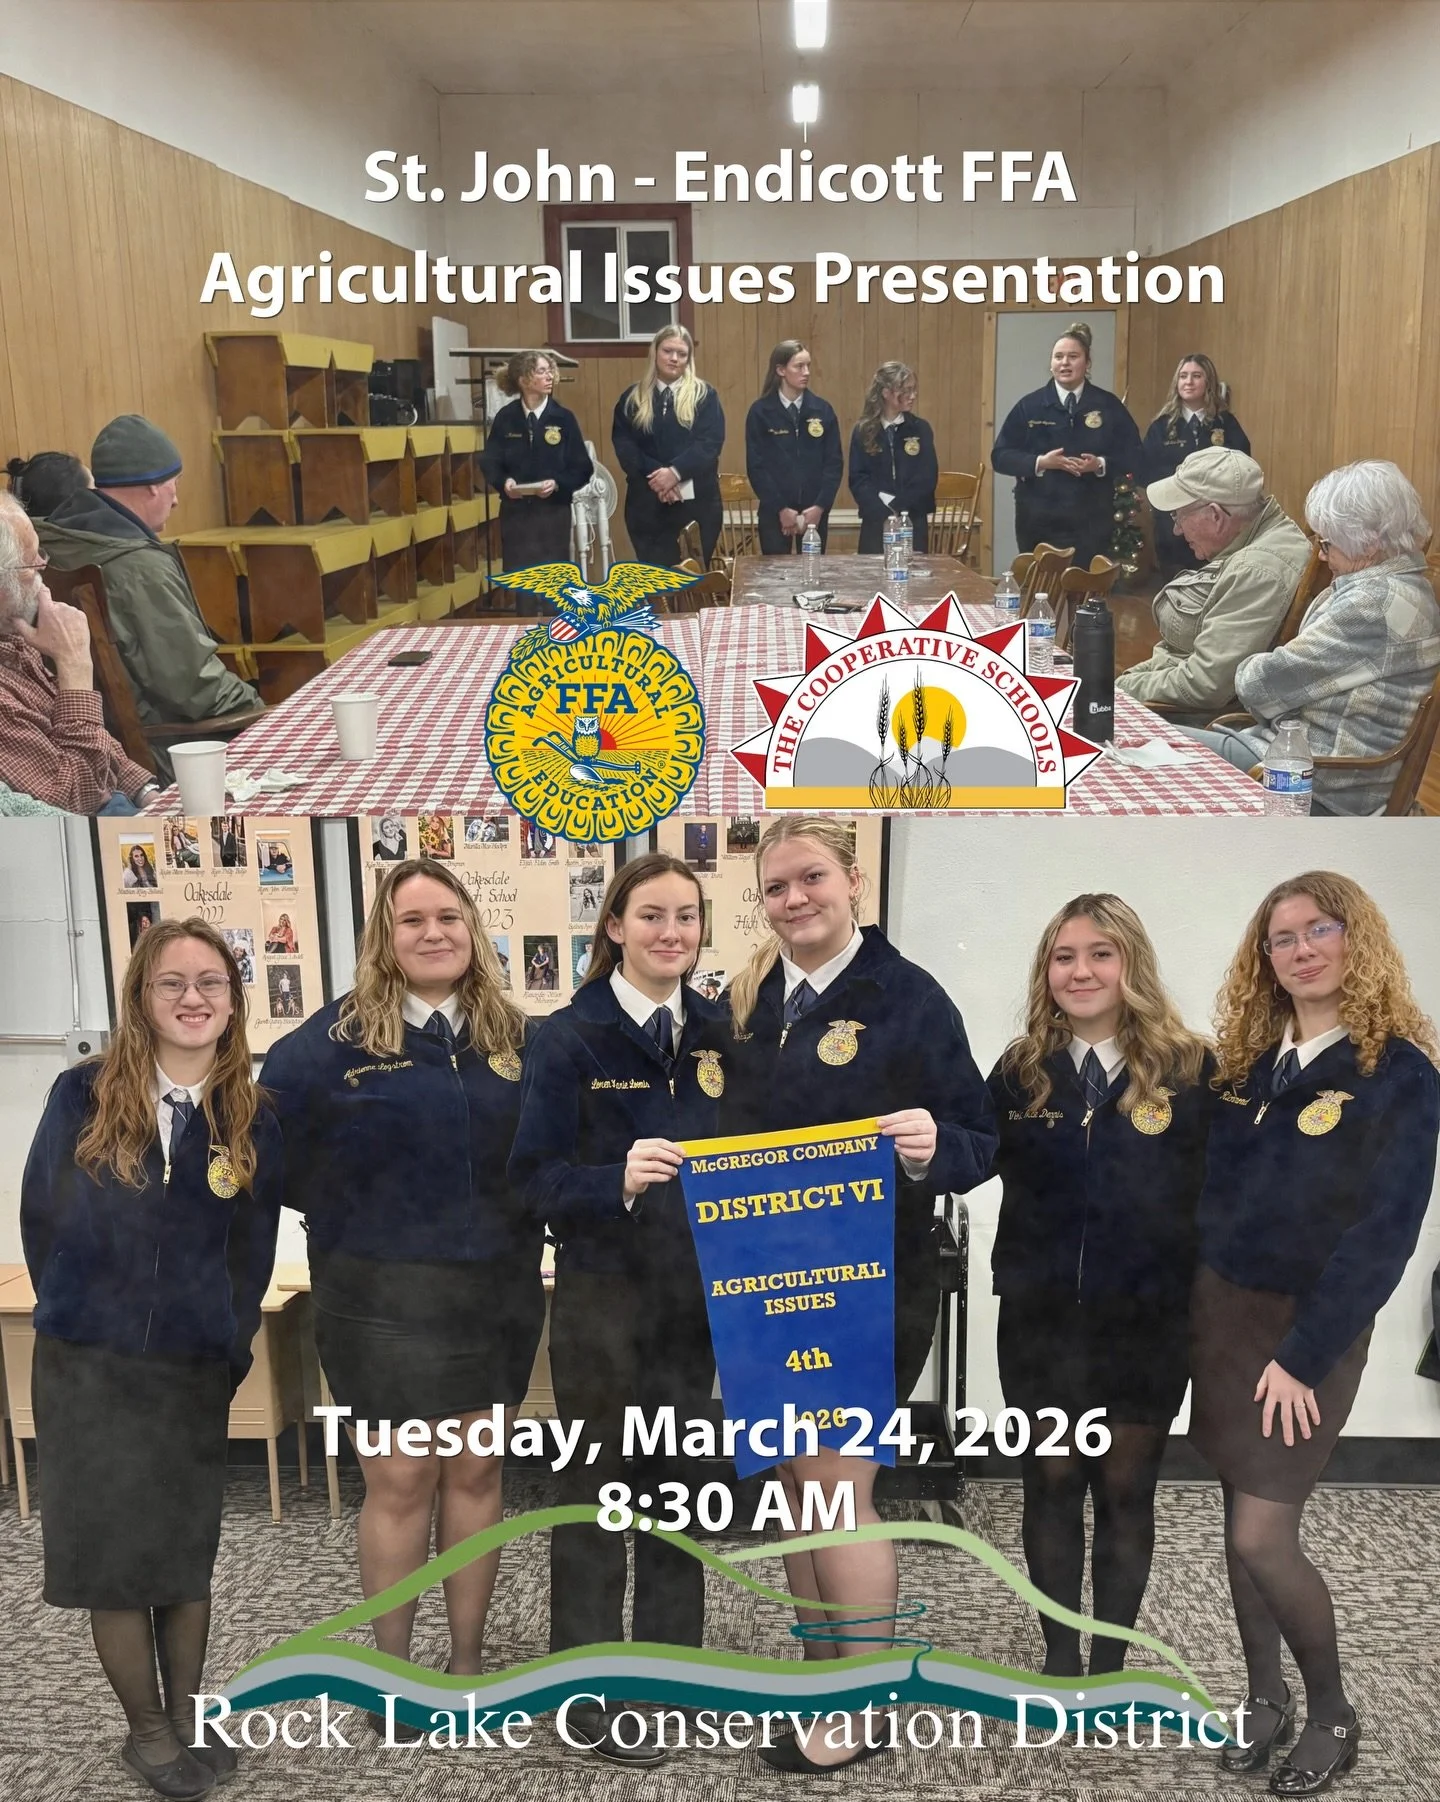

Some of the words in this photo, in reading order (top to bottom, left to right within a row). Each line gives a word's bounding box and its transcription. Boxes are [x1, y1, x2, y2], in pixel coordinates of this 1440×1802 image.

[460, 871, 510, 889] Oakesdale
[184, 881, 233, 905] Oakesdale
[488, 888, 518, 903] School
[481, 908, 514, 930] 023
[734, 915, 759, 936] High
[691, 1150, 790, 1174] McGREGOR
[792, 1136, 879, 1161] COMPANY
[695, 1183, 845, 1224] DISTRICT
[848, 1178, 885, 1203] VI
[711, 1262, 886, 1297] AGRICULTURAL
[764, 1292, 836, 1316] ISSUES
[785, 1347, 832, 1372] 4th
